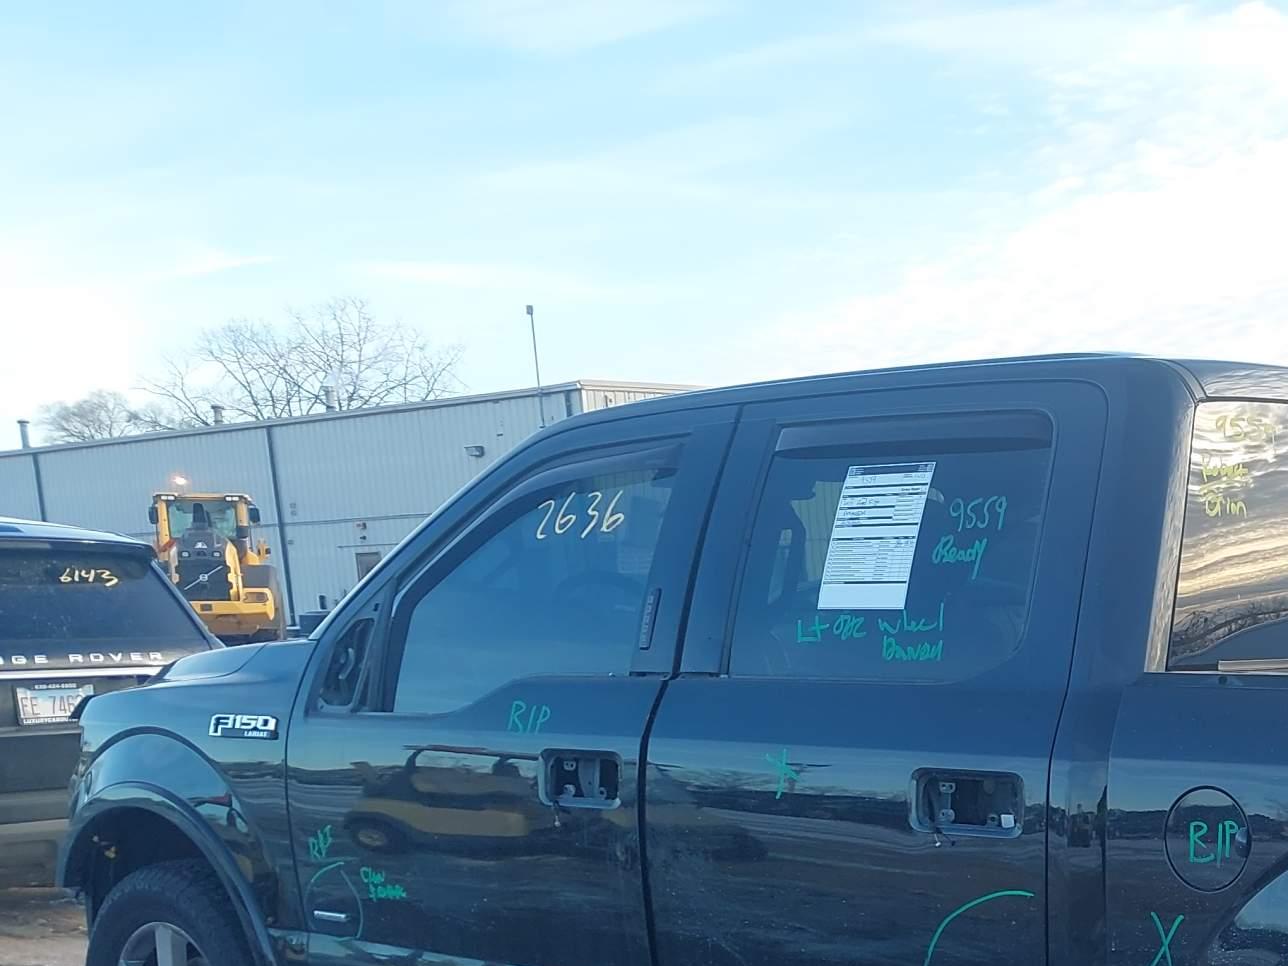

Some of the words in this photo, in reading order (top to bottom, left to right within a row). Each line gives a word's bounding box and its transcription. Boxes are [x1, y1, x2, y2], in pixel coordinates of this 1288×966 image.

[536, 490, 625, 539] 2636
[950, 496, 1007, 532] 9559
[59, 568, 119, 587] 6143
[0, 654, 49, 665] GE
[68, 652, 163, 664] ROVER
[208, 714, 277, 736] F150
